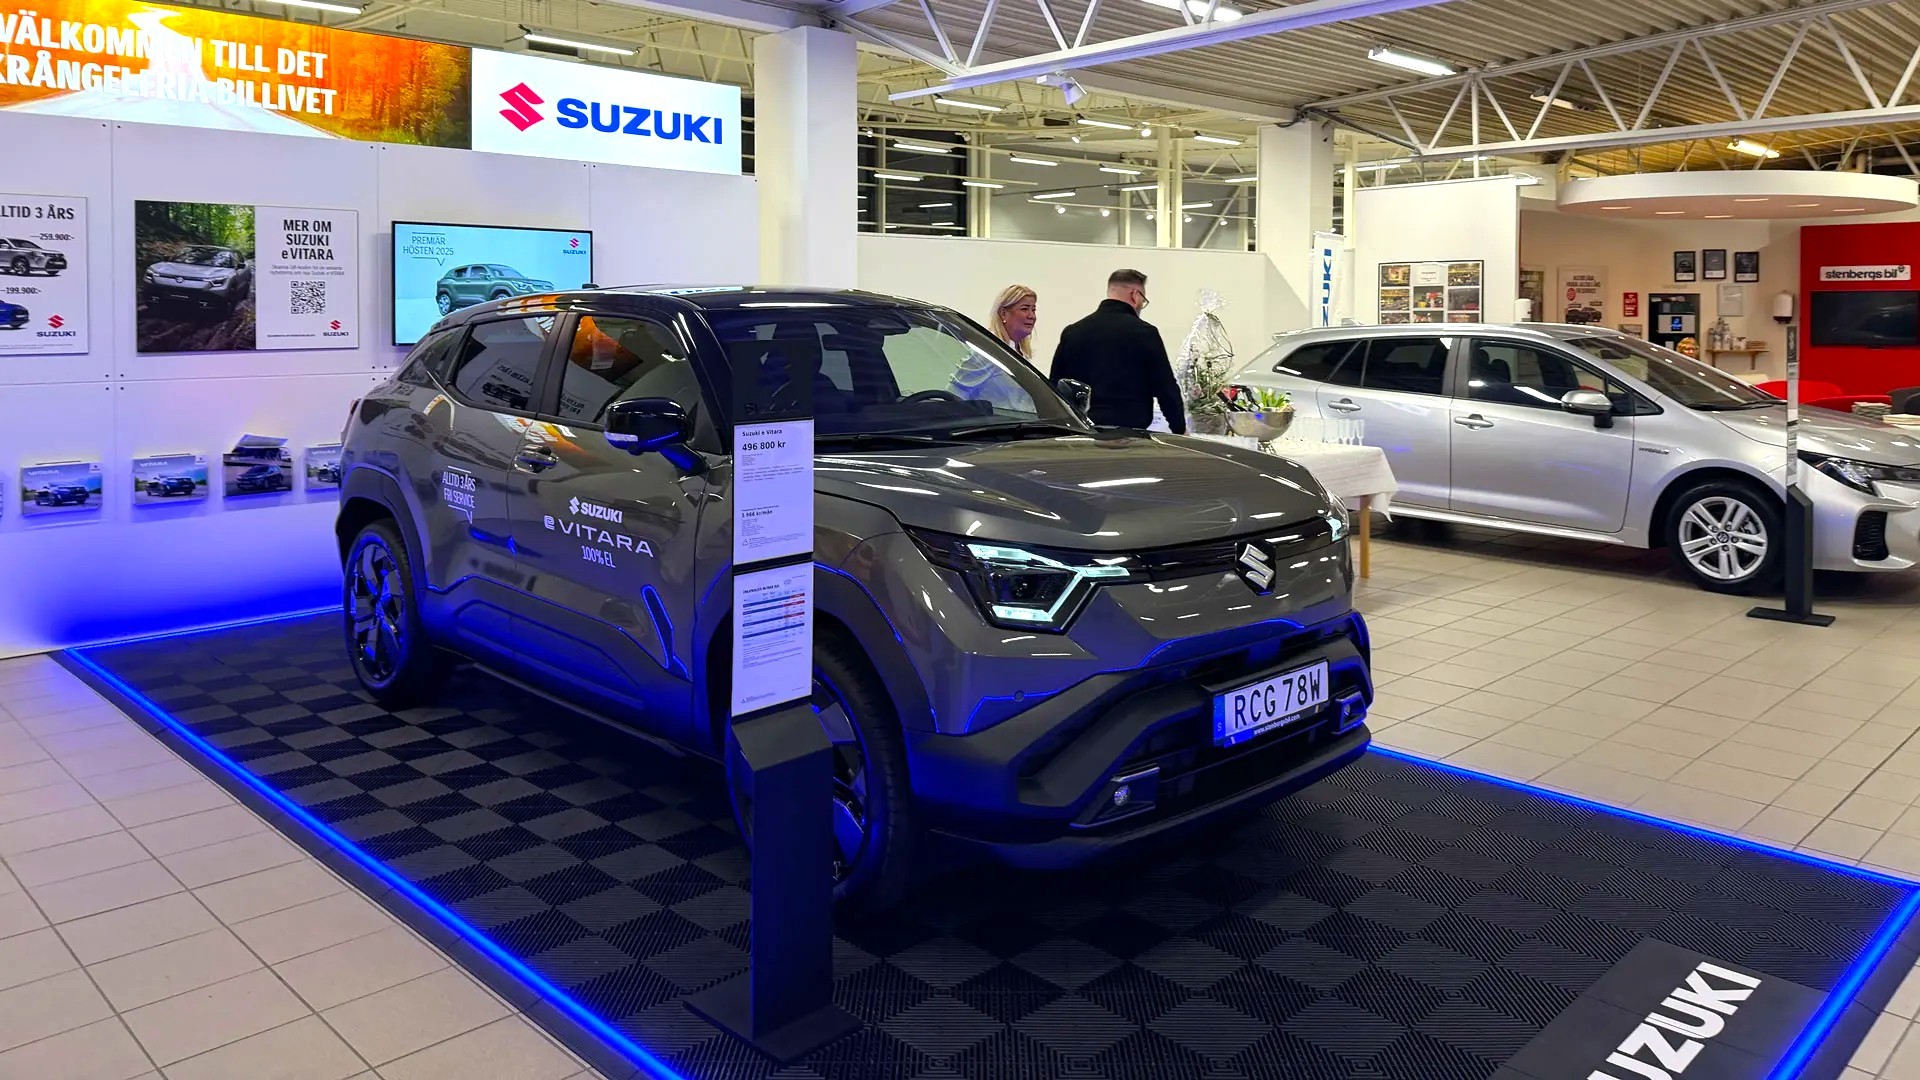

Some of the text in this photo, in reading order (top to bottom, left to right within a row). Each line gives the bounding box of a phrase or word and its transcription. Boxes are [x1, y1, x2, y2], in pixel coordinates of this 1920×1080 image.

[0, 9, 328, 79] VÄLKOMMN TILL DET
[216, 77, 337, 115] BILLIVET
[556, 97, 723, 145] SUZUKI
[0, 203, 75, 220] LTID 3 ÅRS
[283, 219, 332, 233] MER OM
[286, 233, 329, 247] SUZUKI
[281, 248, 334, 261] e VITARA
[402, 244, 454, 256] HÖSTEN 2025
[1825, 269, 1897, 280] stenbergs bil
[742, 429, 760, 437] Suzuki
[742, 440, 786, 451] 496 800 kr
[580, 502, 623, 524] SUZUKI
[558, 518, 654, 558] VITARA
[581, 545, 616, 568] 100% EL
[1234, 668, 1321, 729] RCG 78W
